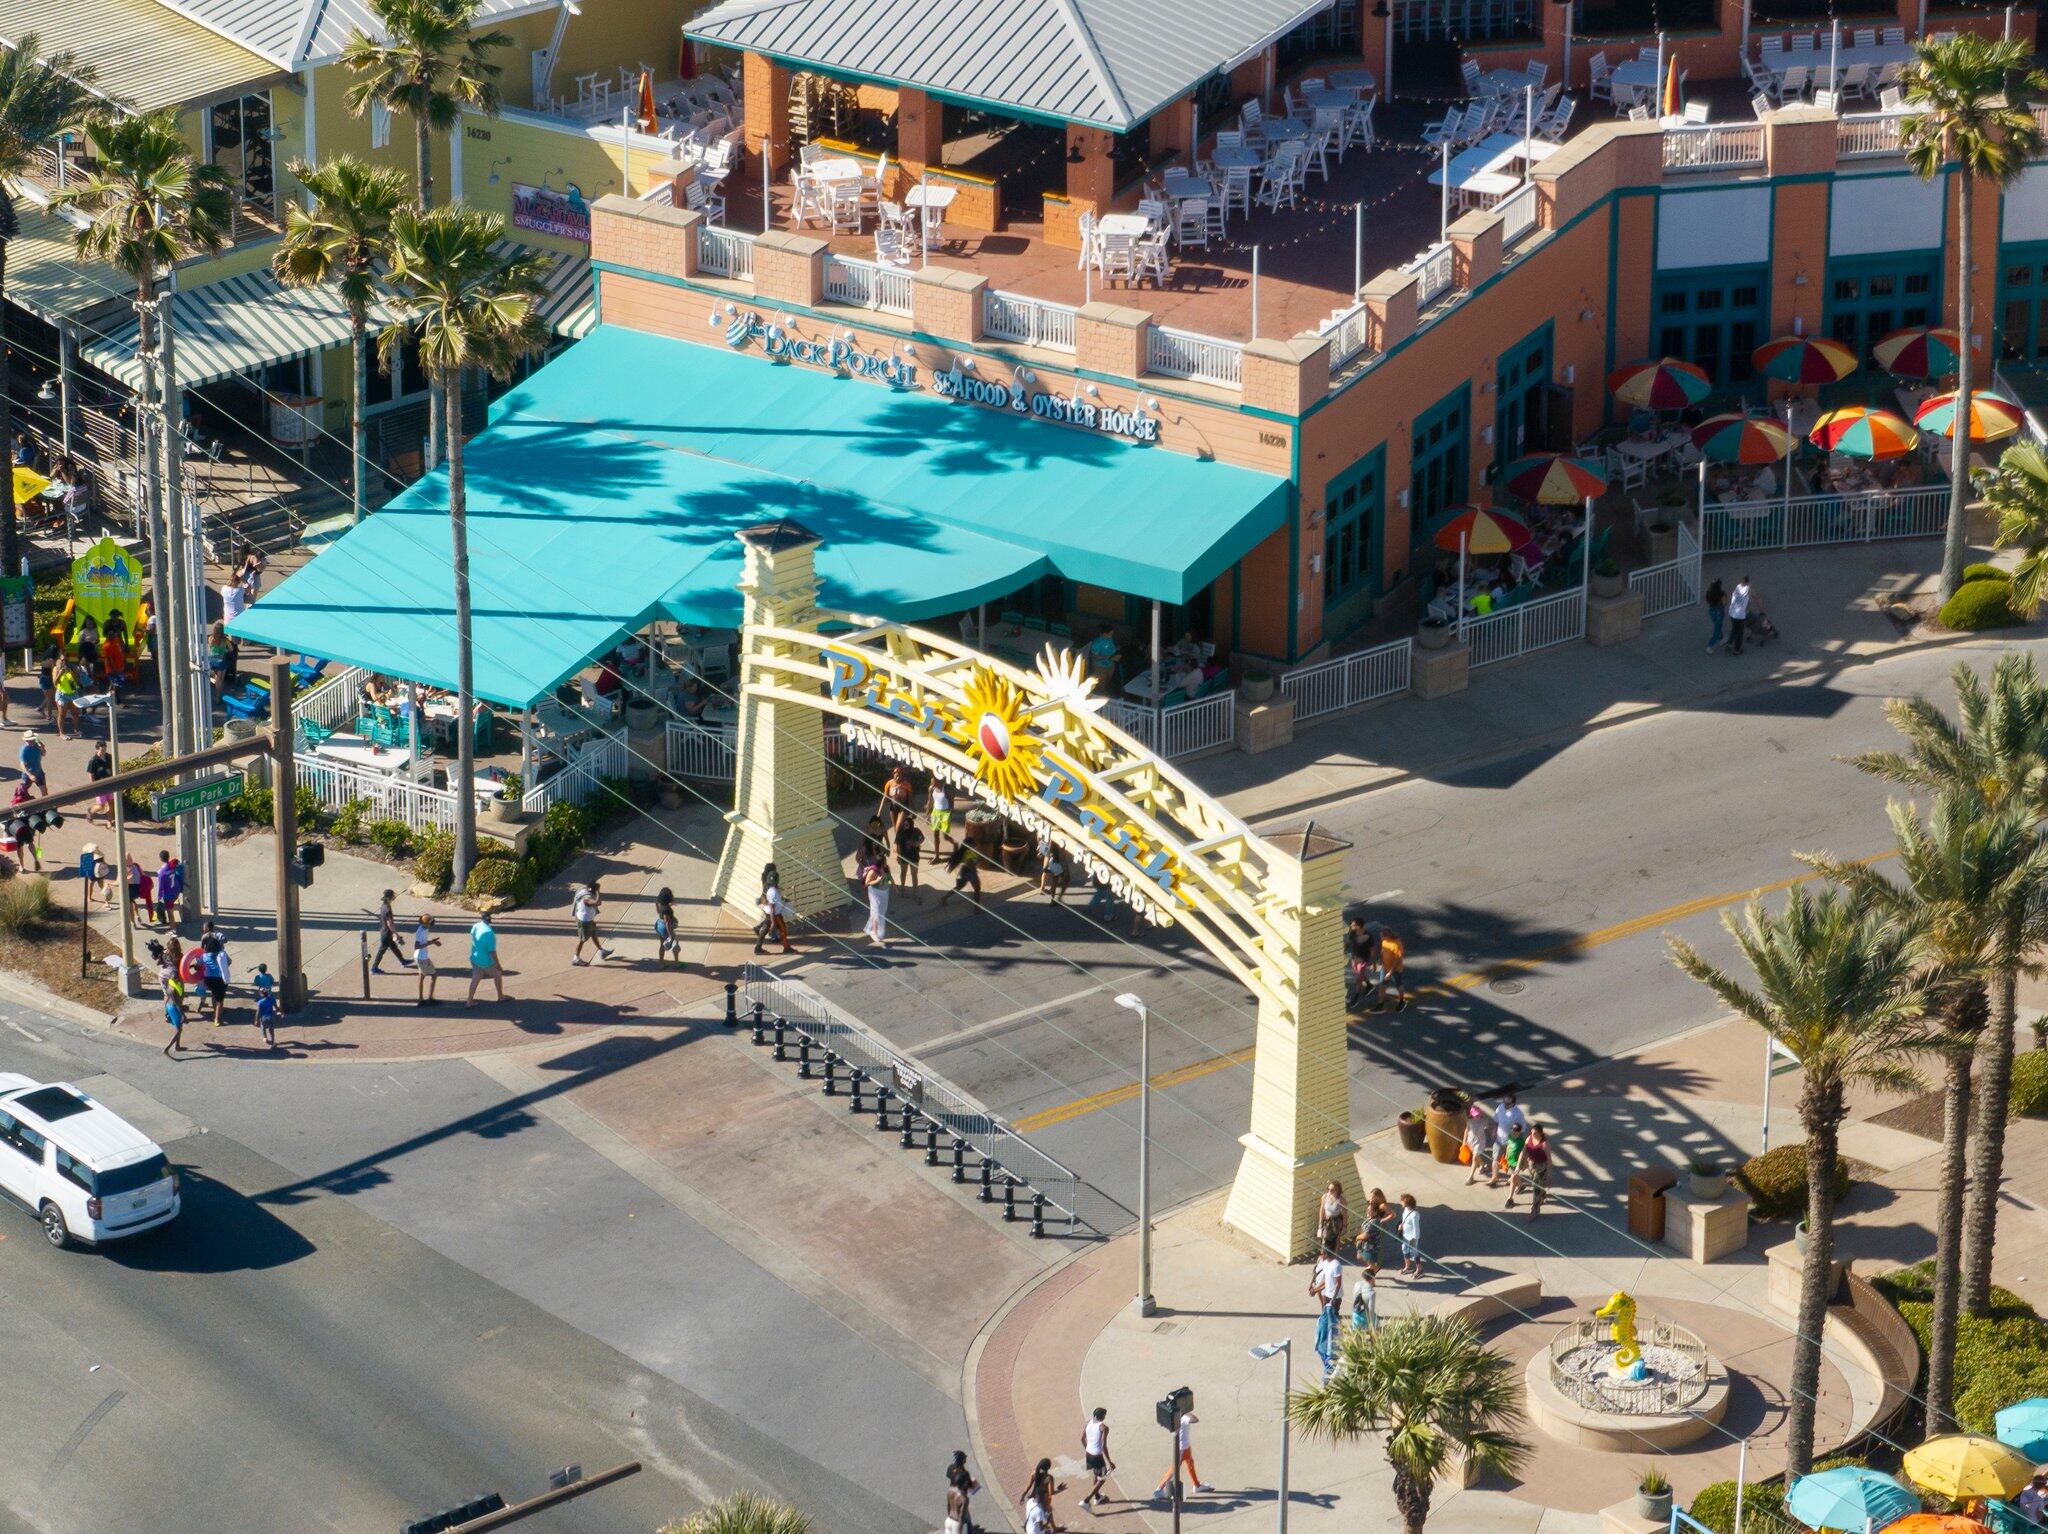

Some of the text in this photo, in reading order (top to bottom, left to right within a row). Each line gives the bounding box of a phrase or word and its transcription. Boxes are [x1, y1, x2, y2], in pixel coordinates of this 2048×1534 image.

[514, 216, 573, 237] SMUGGLER'S
[828, 337, 924, 390] PORCH
[932, 369, 1010, 408] SEAFOOD
[1031, 391, 1097, 429] OYSTER
[1100, 407, 1159, 441] HOUSE
[161, 781, 240, 815] S Pier Park Dr
[821, 643, 1196, 907] Pier Park
[840, 721, 1158, 927] PANAMA CITY BEACH FLORIDA
